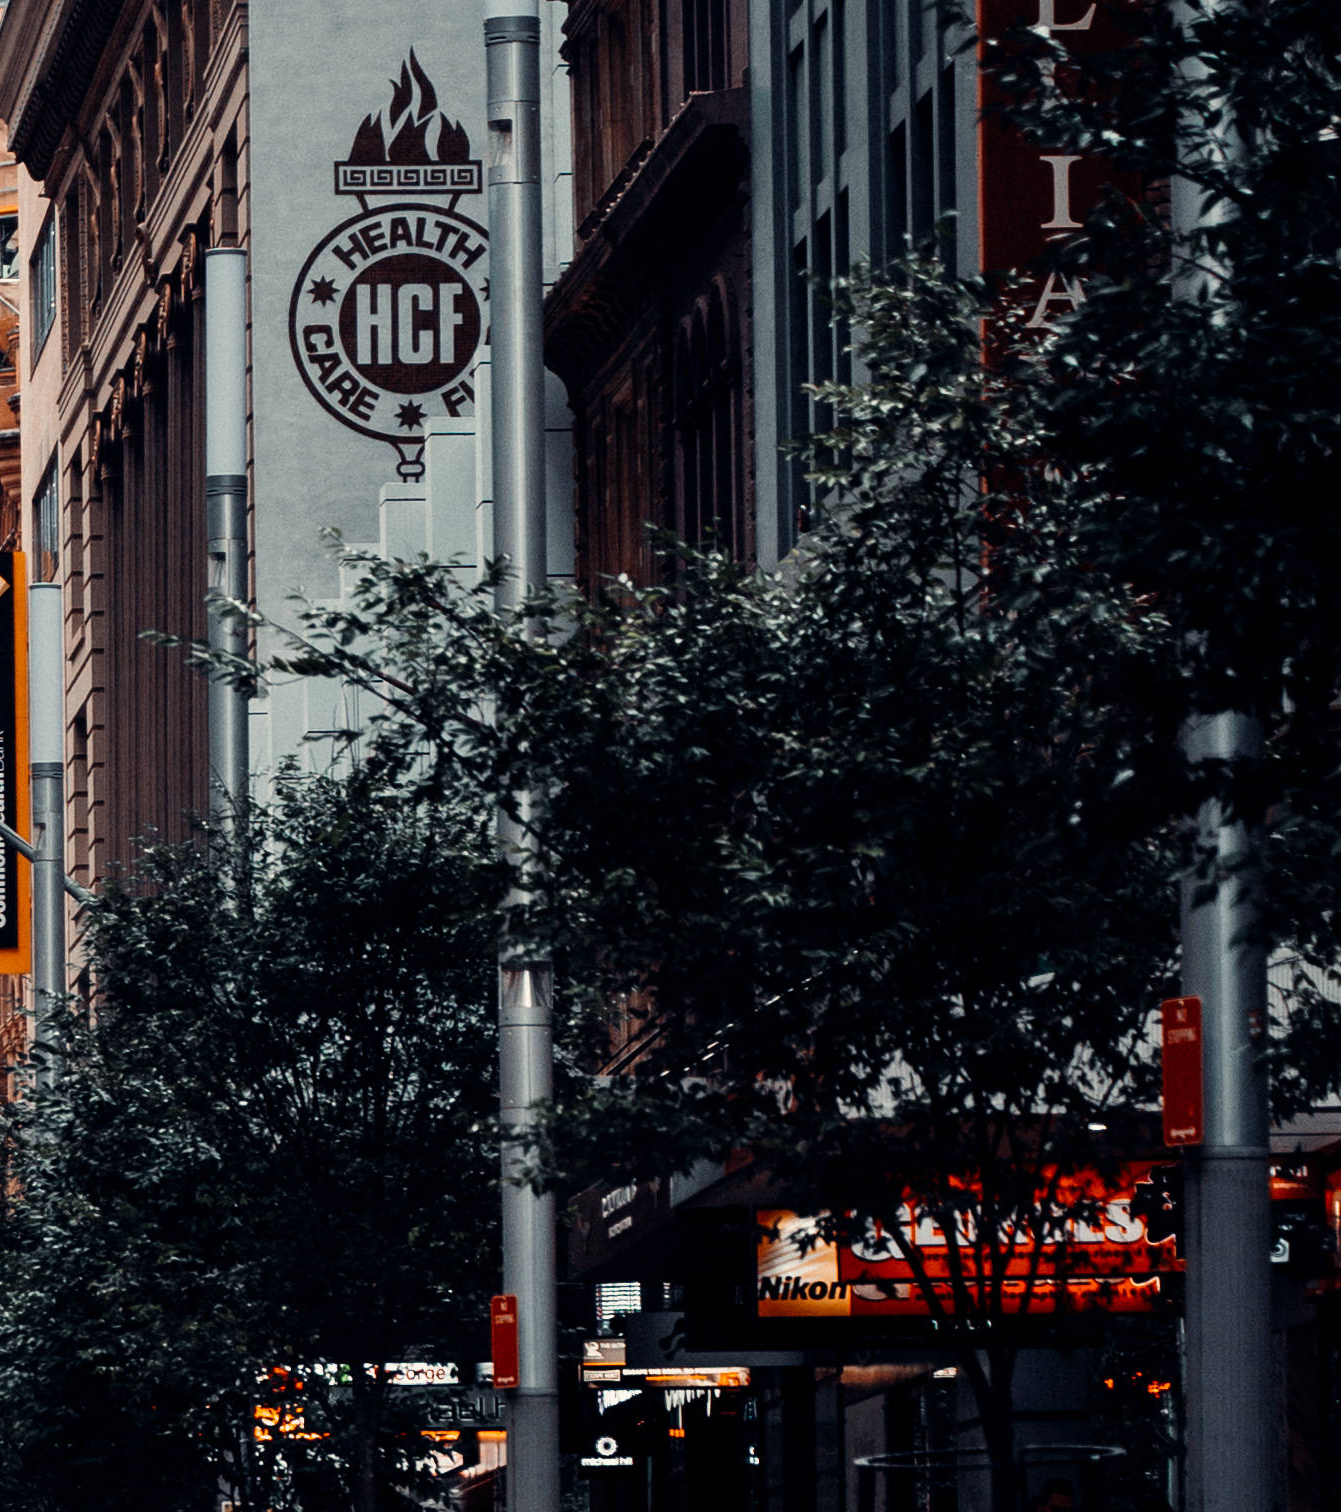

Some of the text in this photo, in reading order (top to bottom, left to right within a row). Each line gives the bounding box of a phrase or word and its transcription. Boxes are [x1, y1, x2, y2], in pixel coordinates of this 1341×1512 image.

[332, 216, 487, 270] HEALTH
[356, 282, 463, 365] HCF
[303, 324, 380, 422] CARE
[759, 1276, 847, 1302] Nikon
[389, 1368, 446, 1382] eorge
